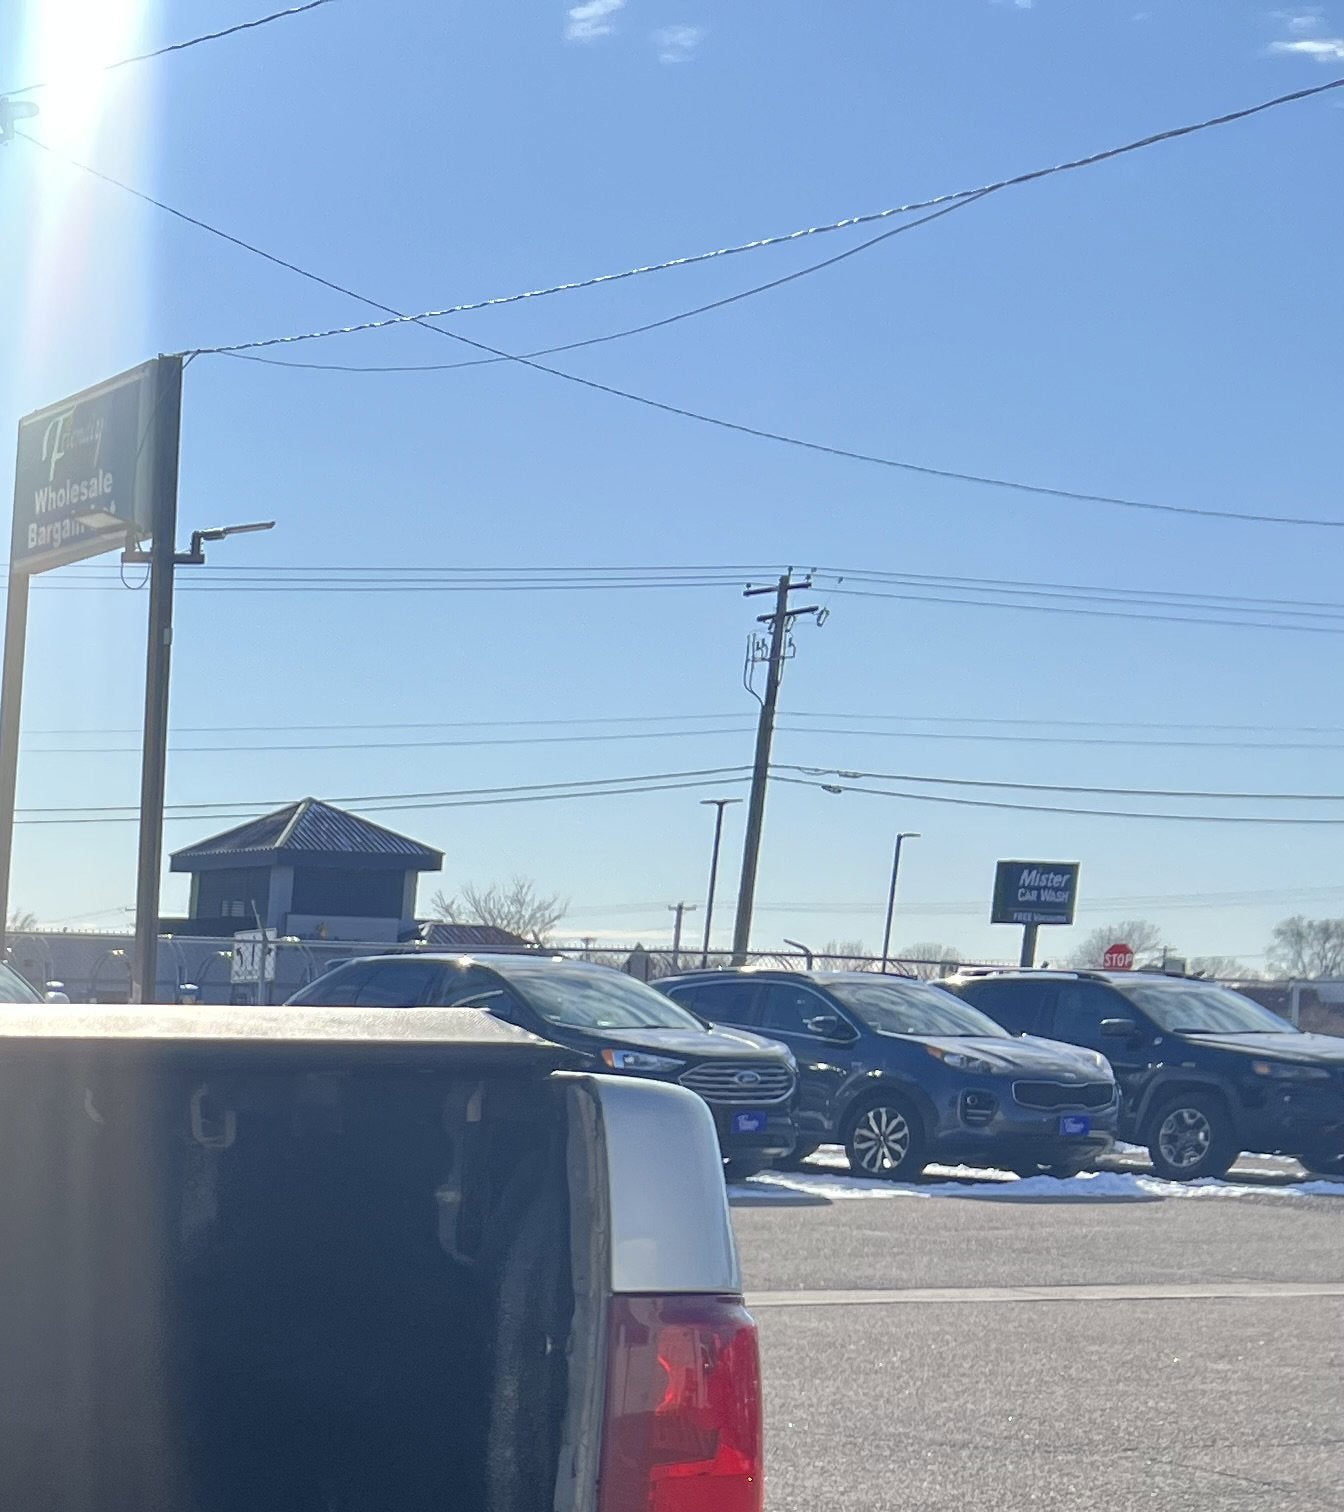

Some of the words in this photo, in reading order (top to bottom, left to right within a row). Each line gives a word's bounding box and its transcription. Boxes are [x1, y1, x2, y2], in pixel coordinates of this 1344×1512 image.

[34, 469, 113, 515] Wholesale
[1018, 869, 1071, 888] Mister
[1104, 953, 1133, 967] STOP
